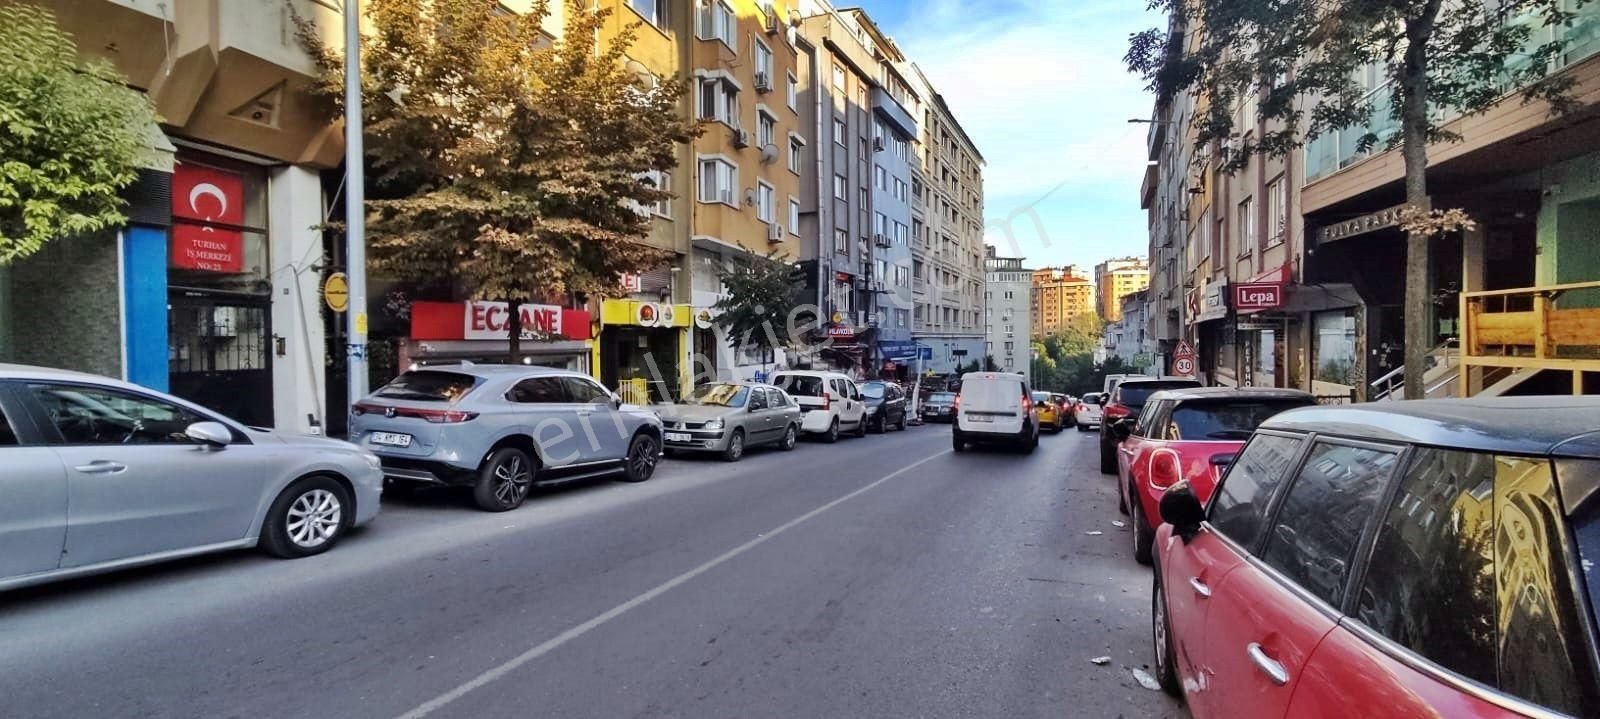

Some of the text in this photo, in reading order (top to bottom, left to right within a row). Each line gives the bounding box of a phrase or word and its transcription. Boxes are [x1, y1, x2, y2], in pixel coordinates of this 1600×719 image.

[1324, 208, 1399, 237] FULYA PARK
[192, 239, 226, 250] TURHAN
[1241, 290, 1275, 306] Lepa
[1178, 361, 1191, 370] 30
[1244, 365, 1252, 388] SHO
